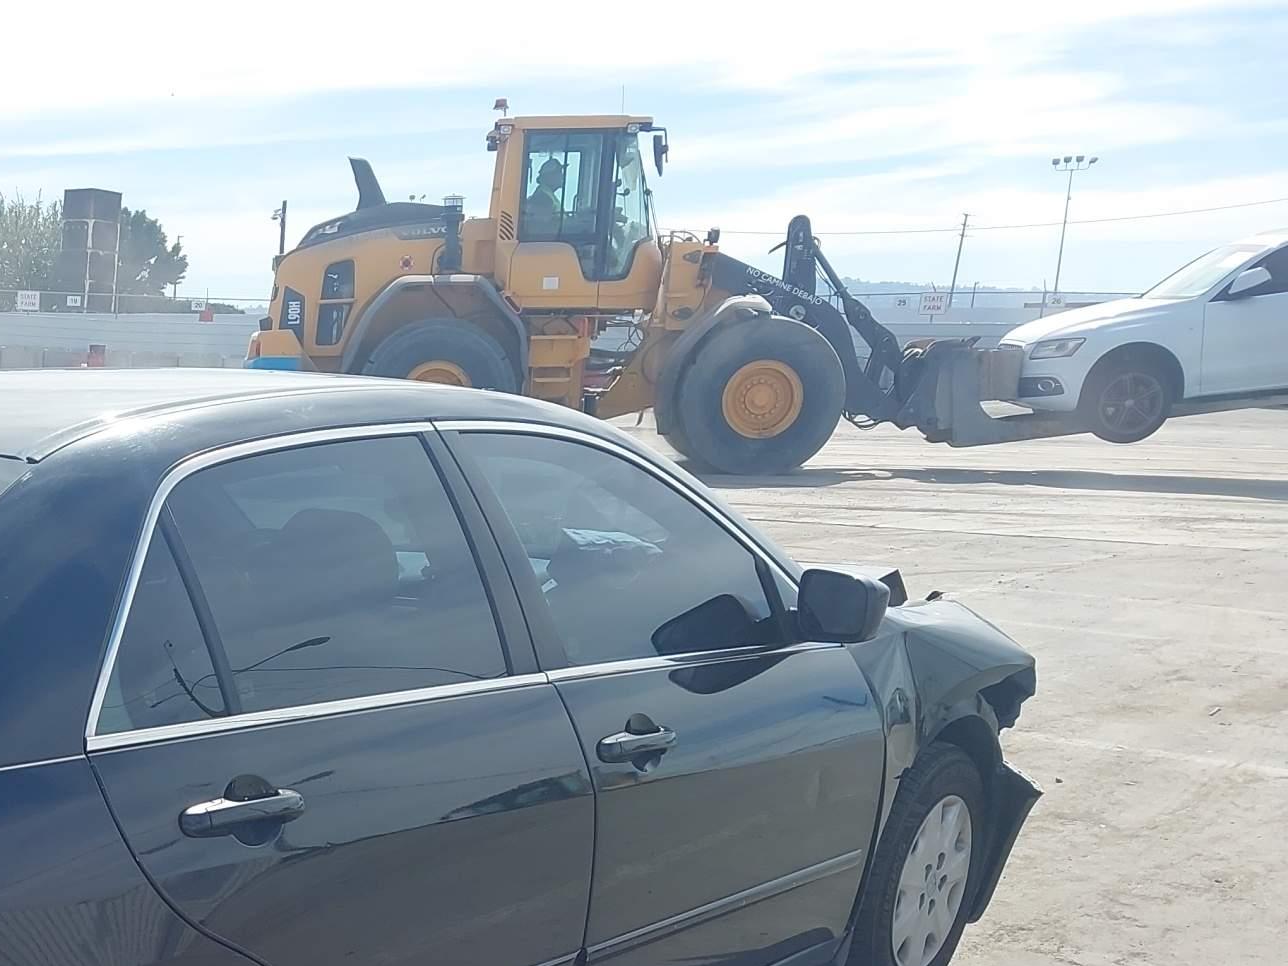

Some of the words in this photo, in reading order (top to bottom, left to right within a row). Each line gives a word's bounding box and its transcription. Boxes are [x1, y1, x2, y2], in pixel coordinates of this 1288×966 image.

[746, 267, 761, 277] NO
[761, 273, 793, 291] CAMINE
[792, 287, 823, 305] DEBAJO
[288, 301, 300, 325] L90H
